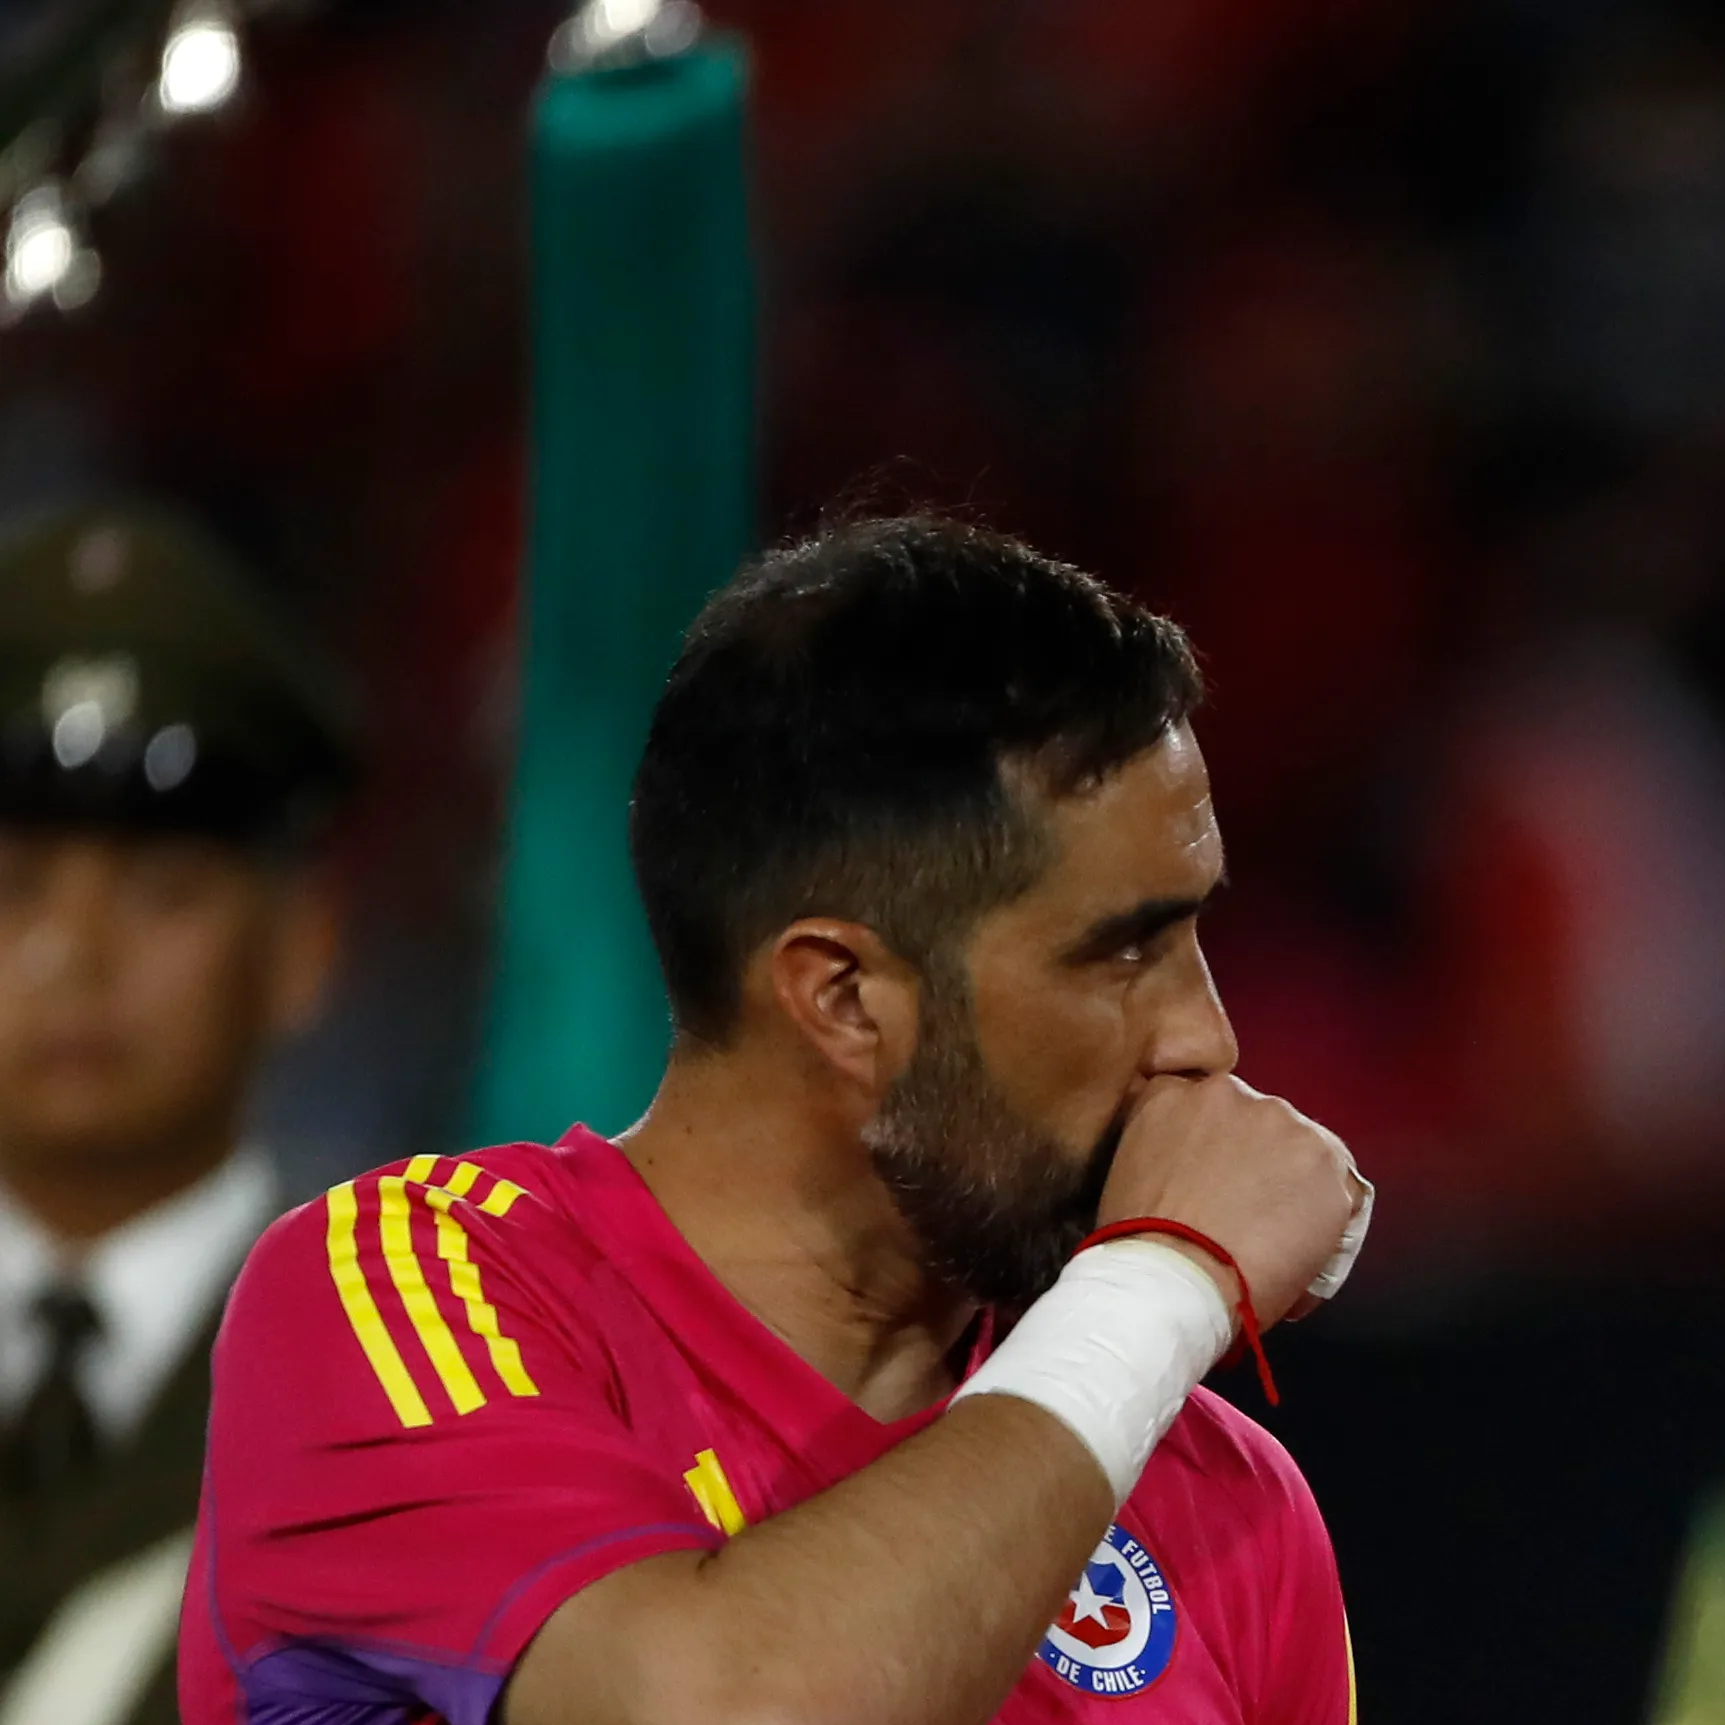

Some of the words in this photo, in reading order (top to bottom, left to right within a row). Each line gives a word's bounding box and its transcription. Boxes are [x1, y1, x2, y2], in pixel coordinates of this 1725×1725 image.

[1103, 1524, 1116, 1542] E
[1121, 1539, 1171, 1614] FUTBOL
[1056, 1656, 1081, 1683] DE
[1091, 1664, 1145, 1692] CHILE
